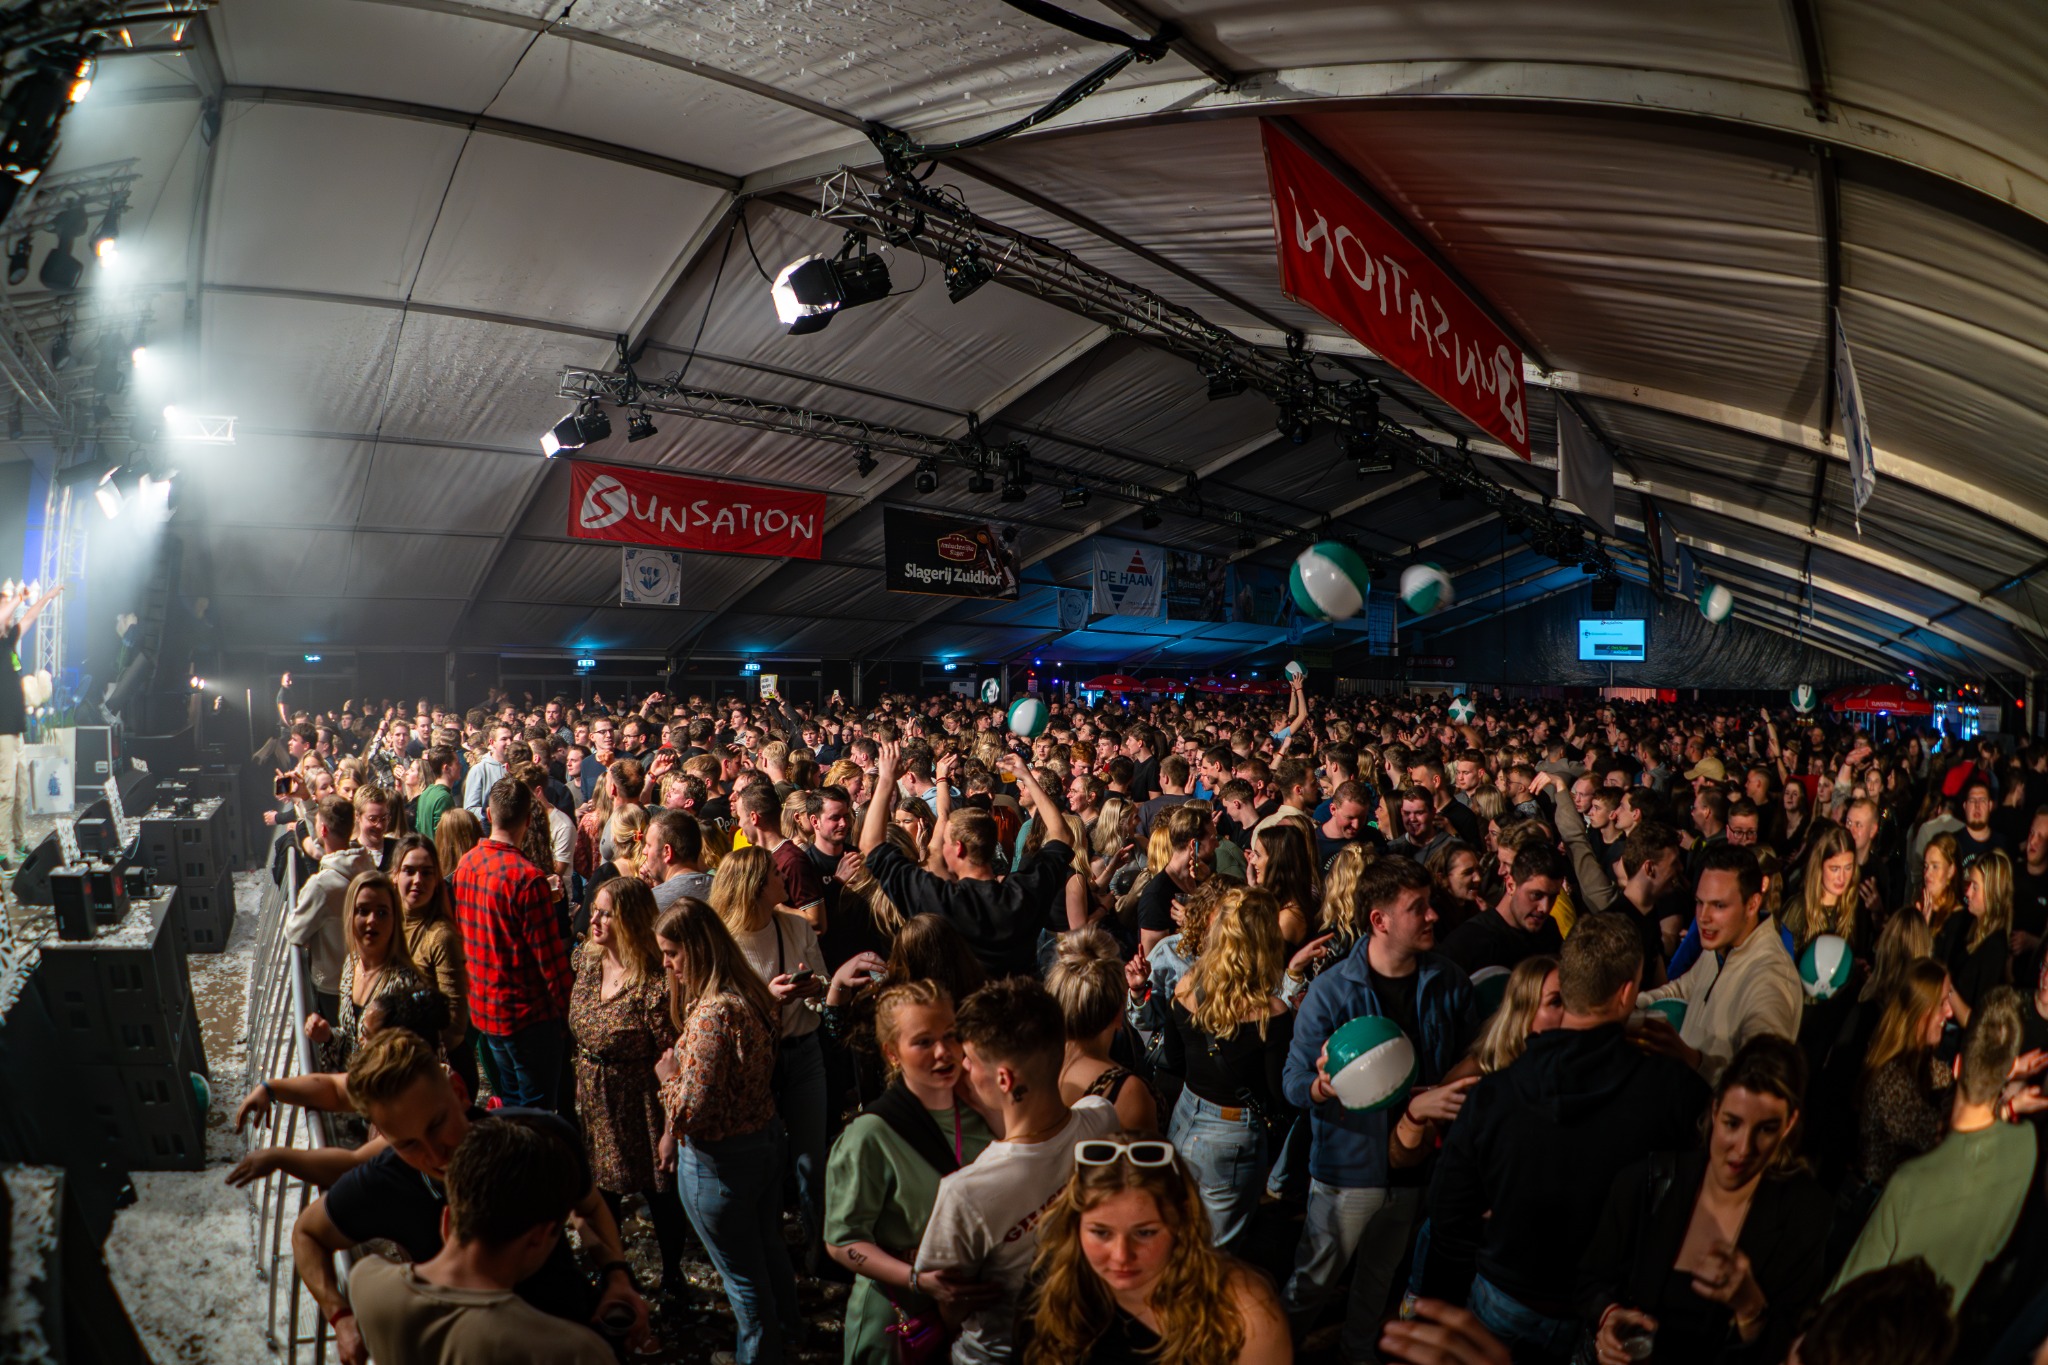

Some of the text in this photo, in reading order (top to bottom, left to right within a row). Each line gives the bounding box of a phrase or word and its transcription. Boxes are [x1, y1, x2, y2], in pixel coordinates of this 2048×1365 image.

[580, 474, 815, 539] SUNSATION
[904, 562, 1002, 586] Slagerij Zuidhof
[1100, 570, 1153, 587] DE HAAN
